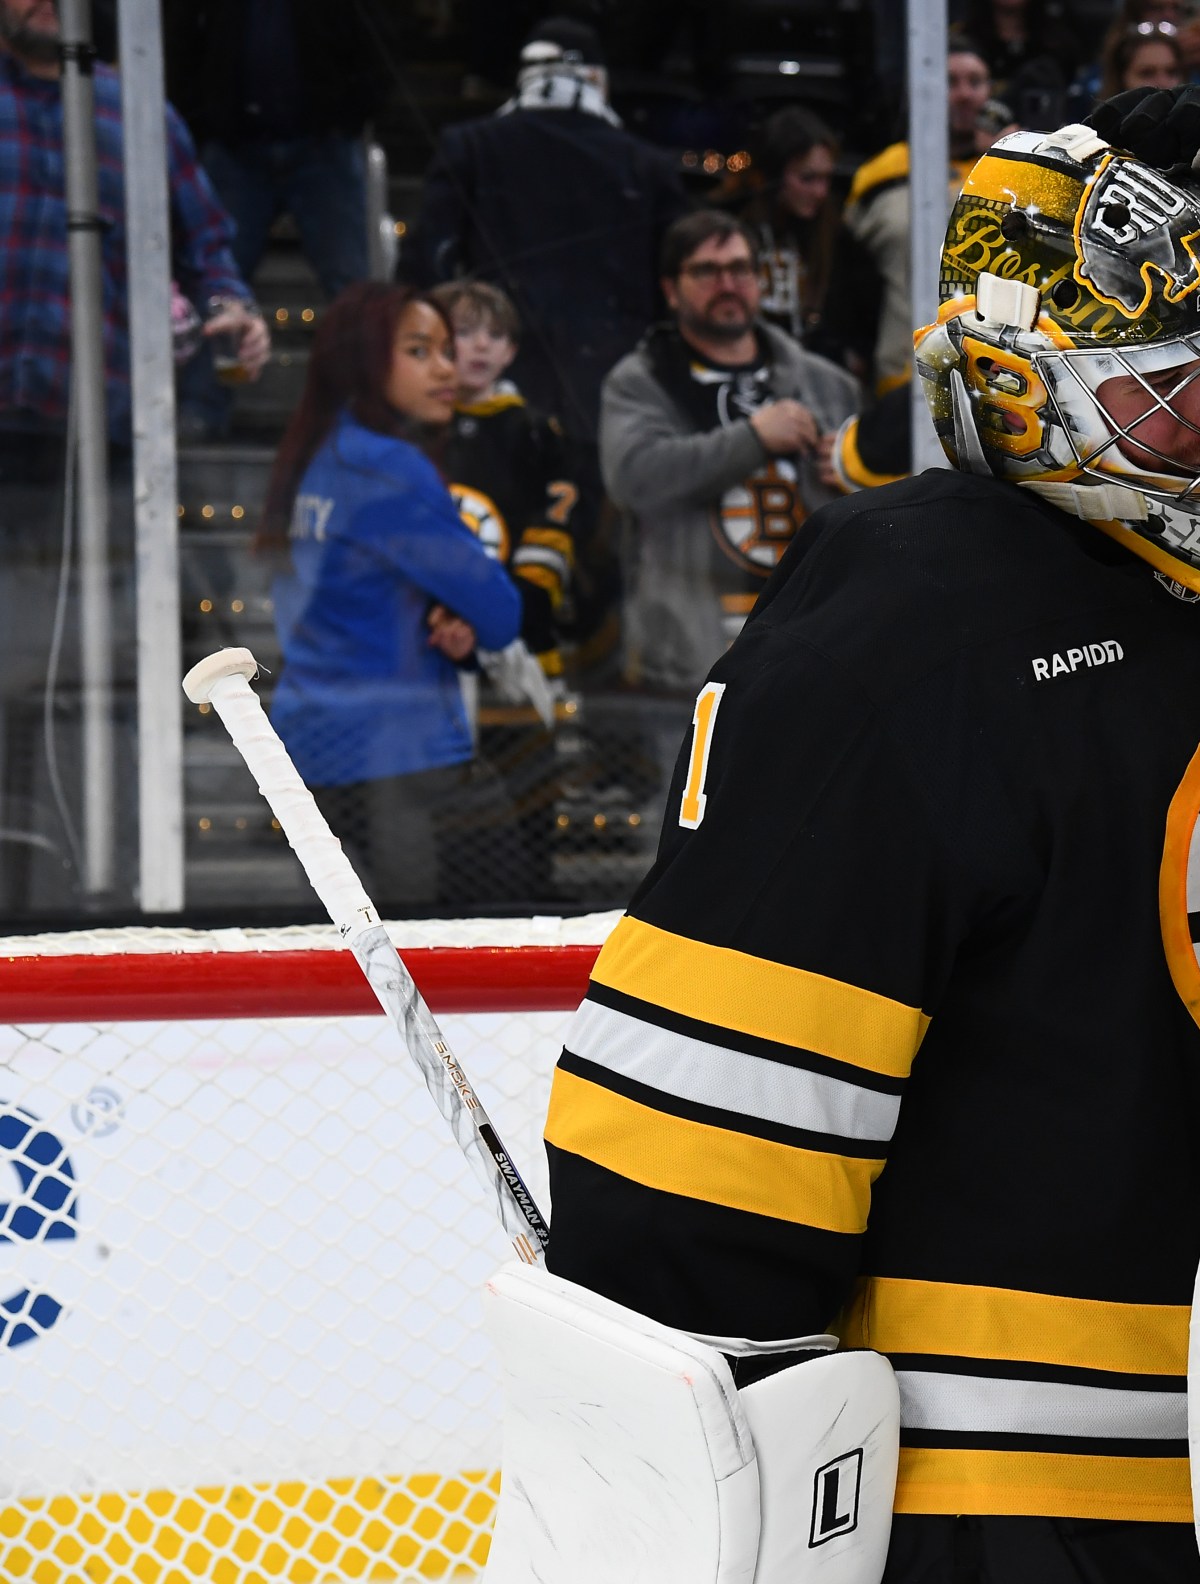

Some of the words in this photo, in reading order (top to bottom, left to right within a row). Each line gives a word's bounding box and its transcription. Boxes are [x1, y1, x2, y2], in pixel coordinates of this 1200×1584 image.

[678, 681, 727, 831] 1
[434, 1040, 479, 1110] SMOKE
[495, 1152, 540, 1224] SWAYMAN
